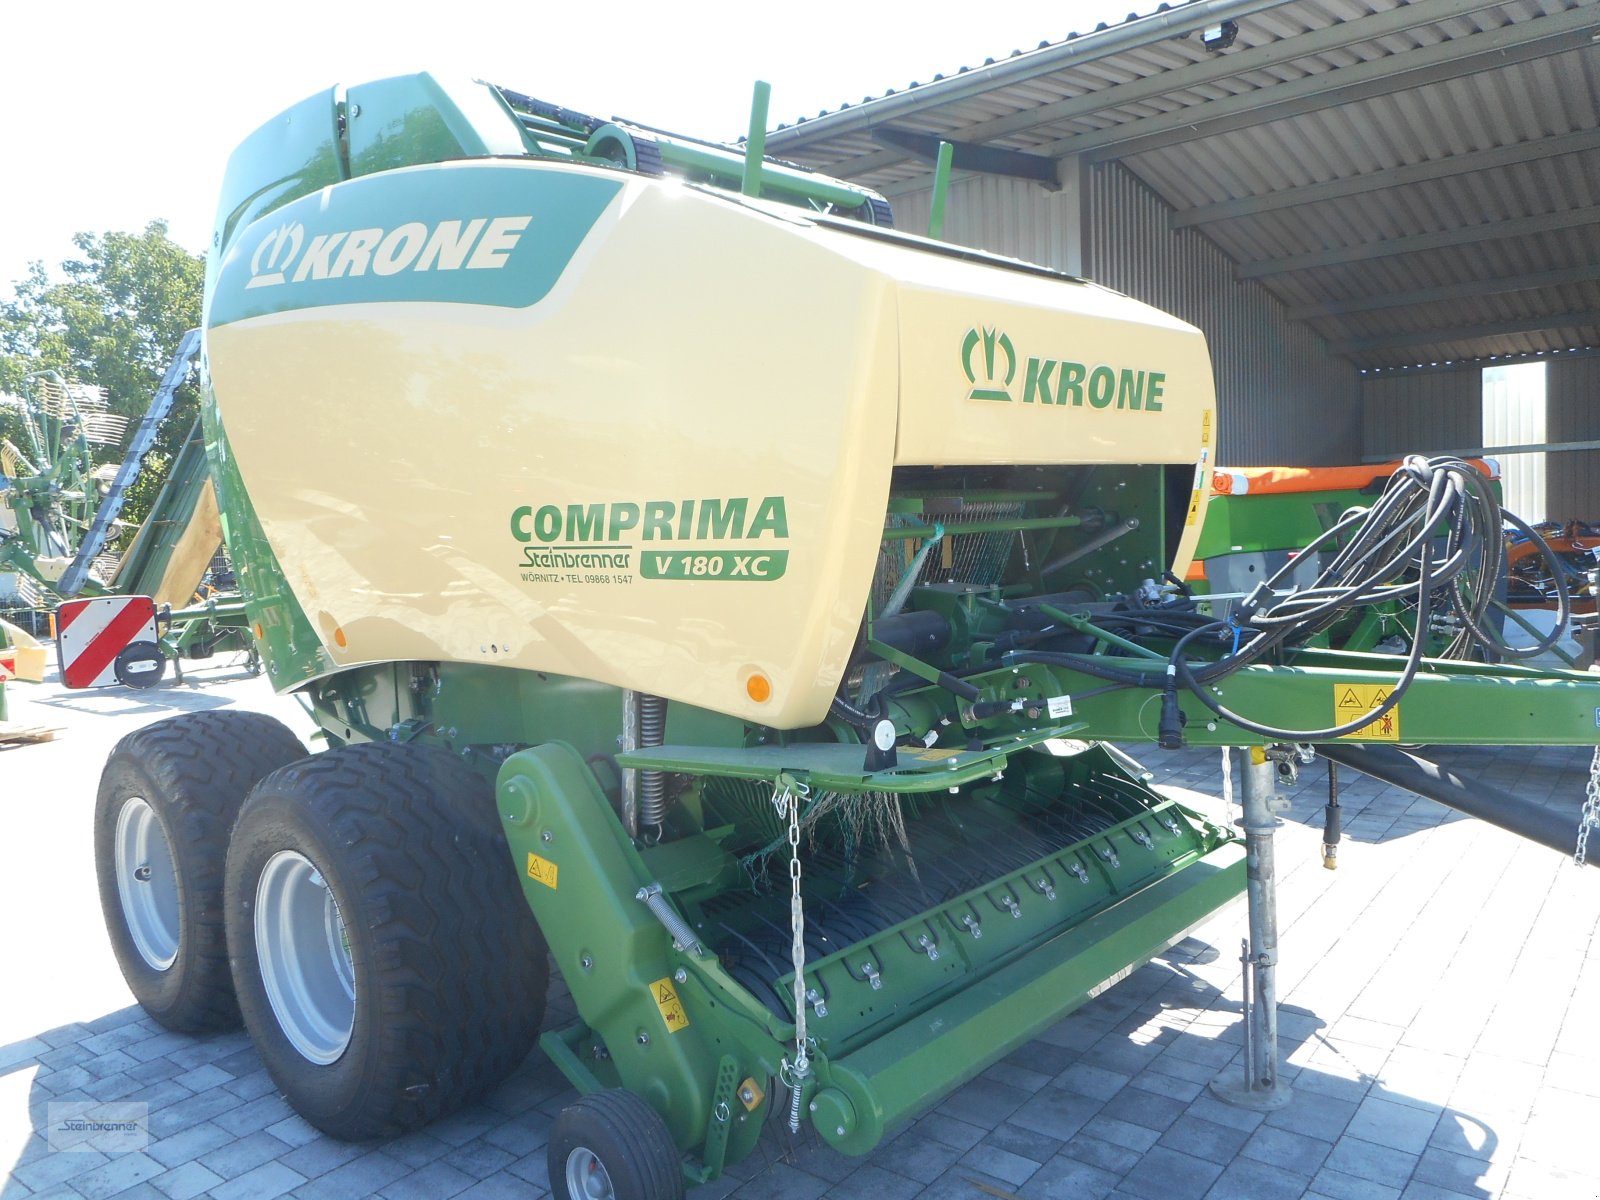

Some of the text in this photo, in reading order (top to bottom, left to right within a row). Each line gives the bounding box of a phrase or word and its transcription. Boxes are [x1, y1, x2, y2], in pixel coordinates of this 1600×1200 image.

[292, 216, 533, 282] KRONE
[1022, 357, 1166, 412] KRONE
[510, 496, 789, 543] COMPRIMA
[519, 546, 632, 568] Steinbrenner
[655, 556, 771, 576] V 180 XC
[521, 571, 633, 584] WÖRNITZ TEL 09868 1547
